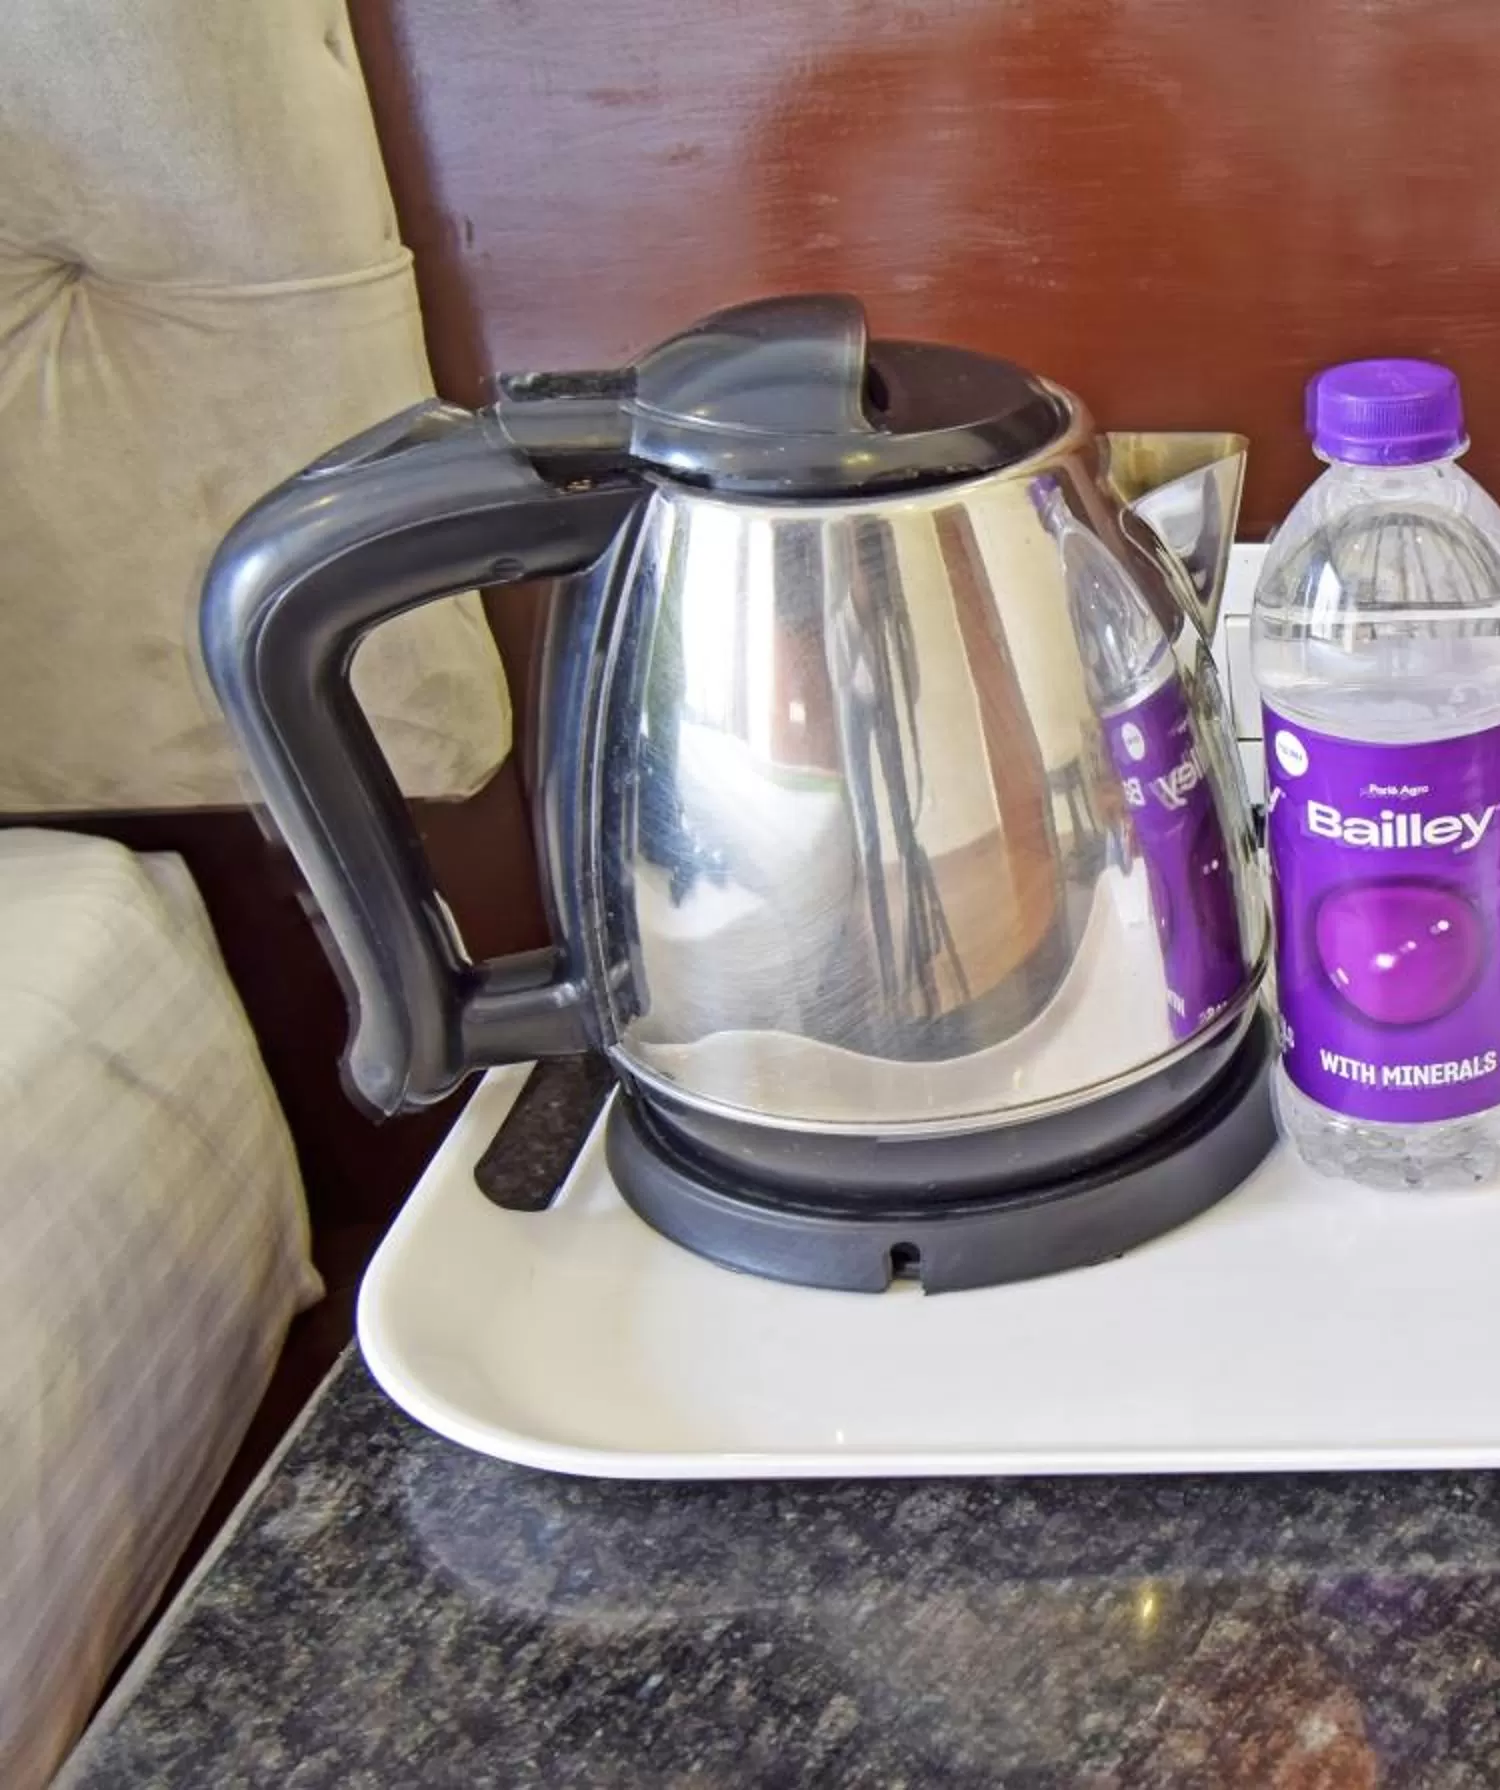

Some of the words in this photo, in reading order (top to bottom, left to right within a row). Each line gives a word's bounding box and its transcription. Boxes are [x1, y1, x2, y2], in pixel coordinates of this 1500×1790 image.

[1306, 799, 1500, 851] Bailley
[1320, 1048, 1377, 1085] WITH
[1382, 1050, 1497, 1087] MINERALS
